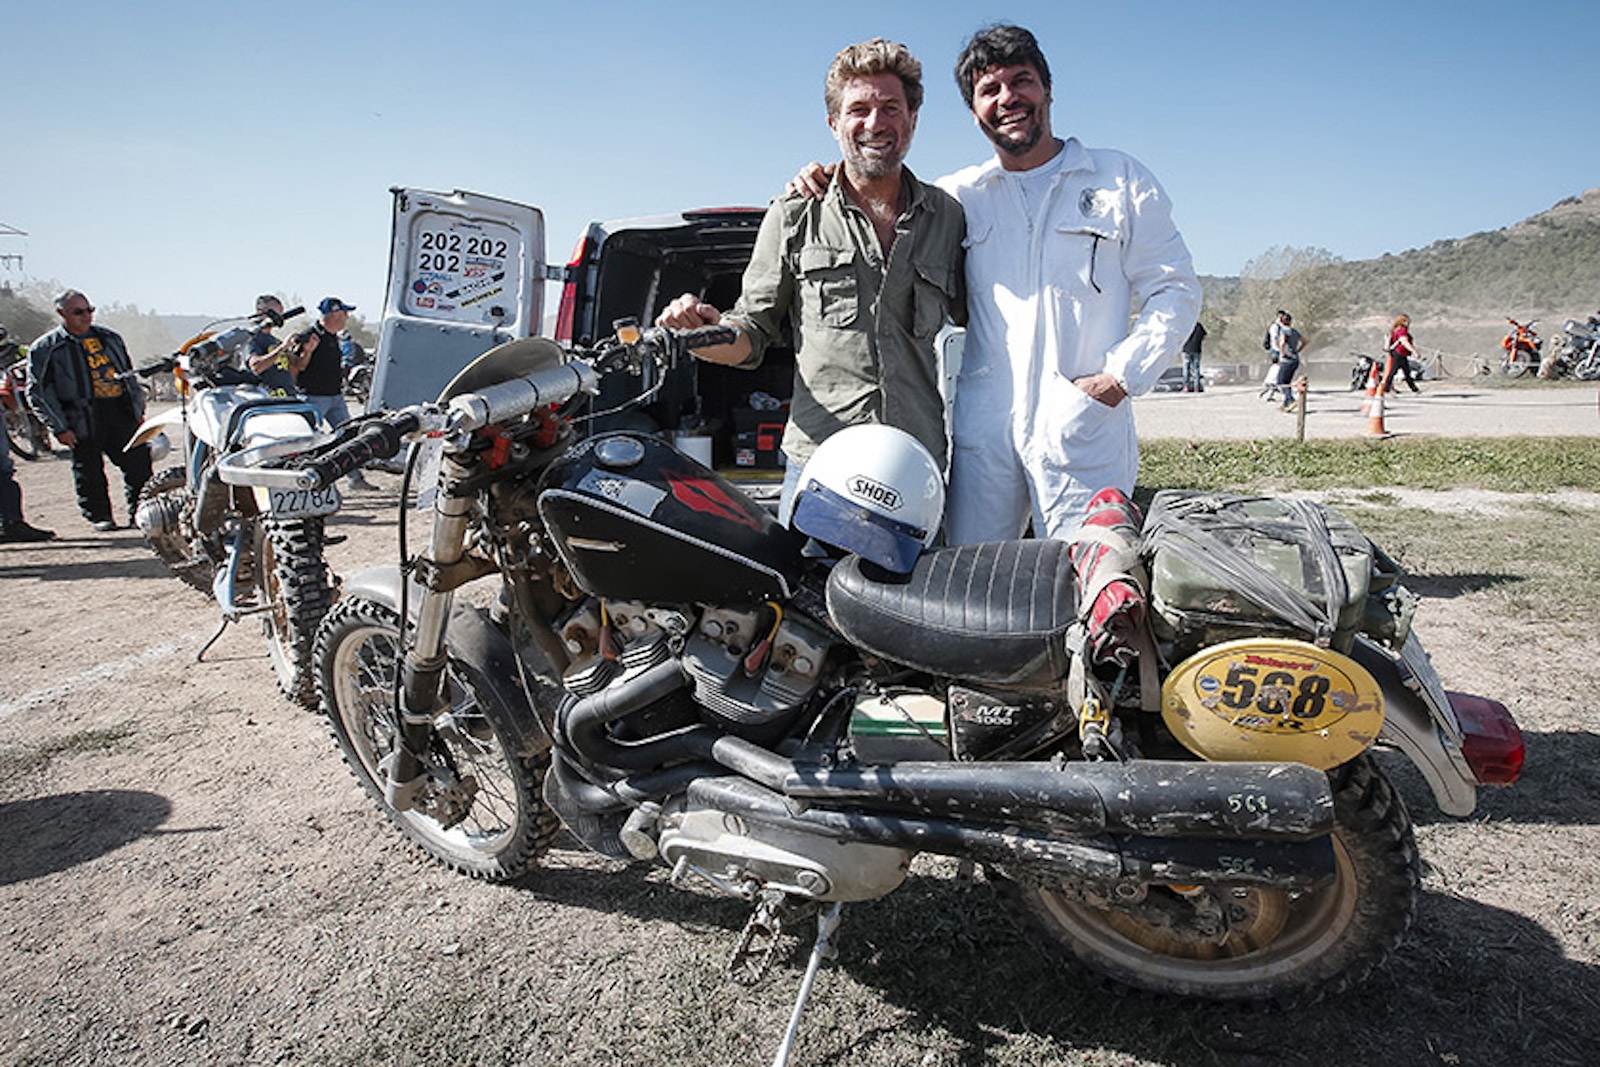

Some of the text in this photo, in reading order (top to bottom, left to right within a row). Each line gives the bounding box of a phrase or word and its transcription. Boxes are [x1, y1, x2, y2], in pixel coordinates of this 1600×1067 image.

[421, 232, 507, 258] 202 202
[419, 253, 460, 272] 202
[853, 479, 897, 507] SHOEI
